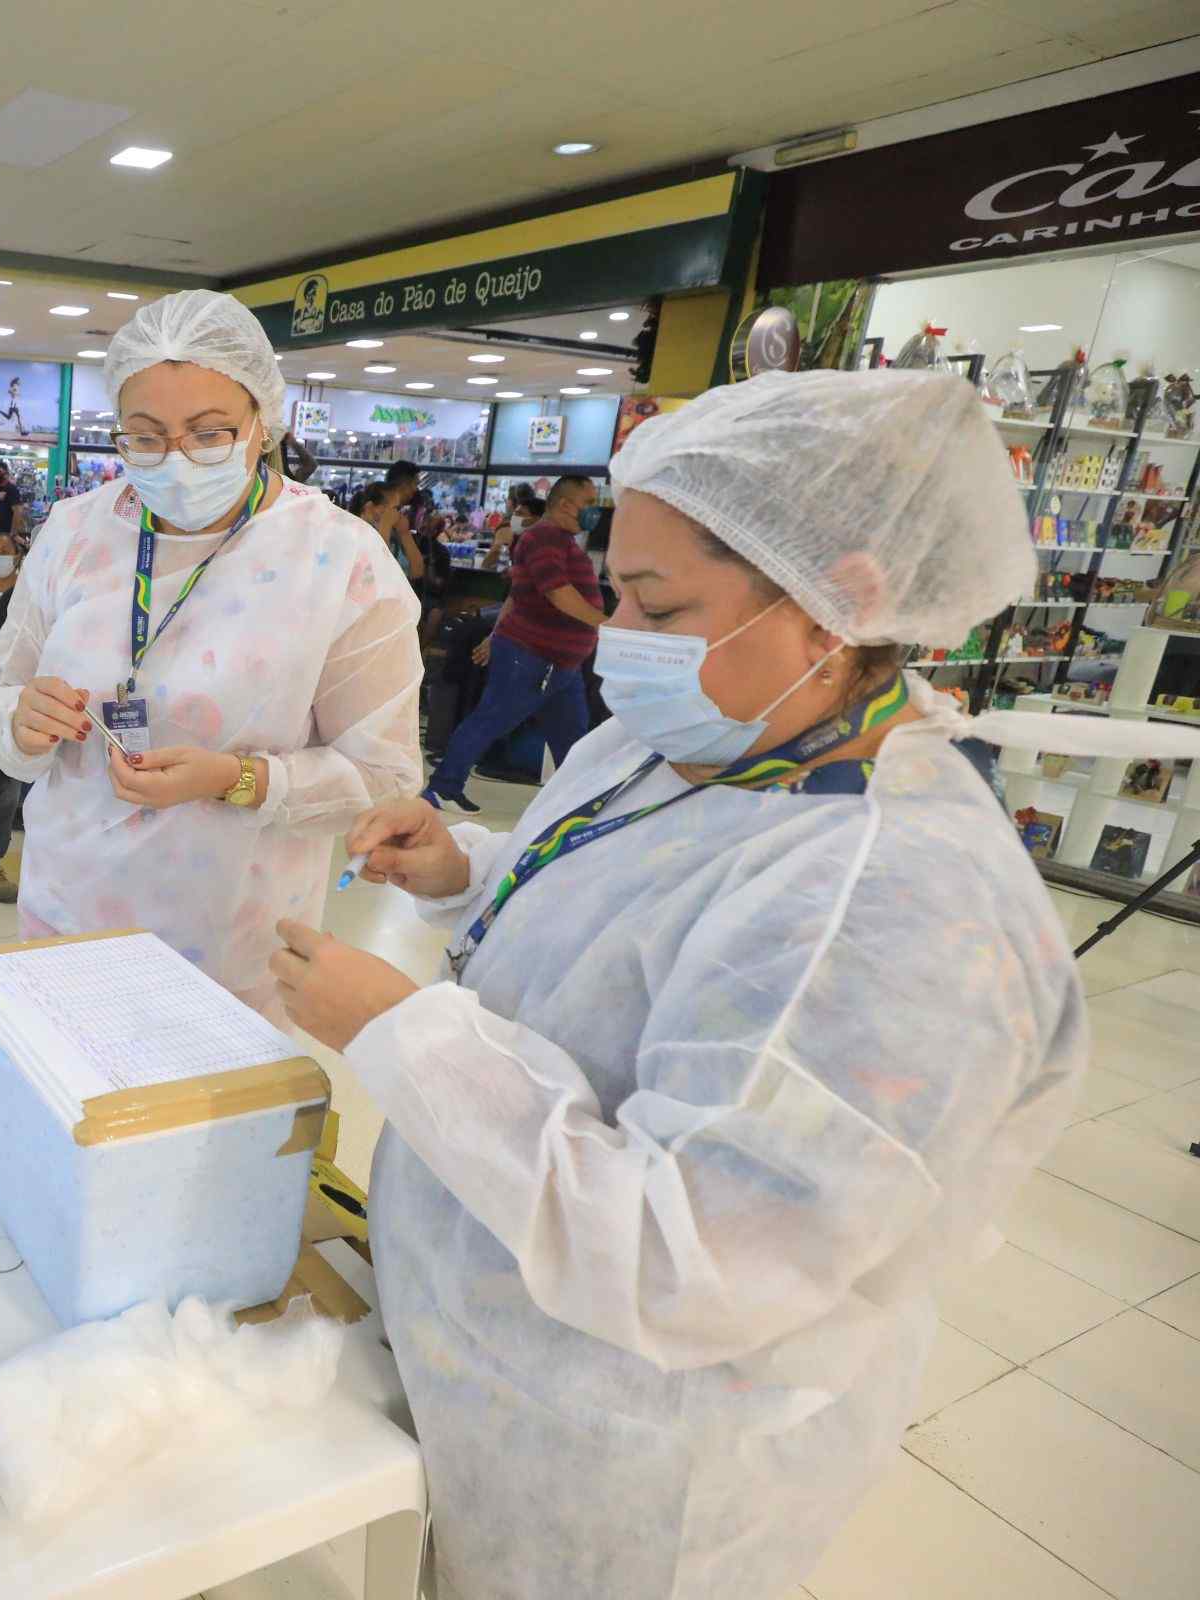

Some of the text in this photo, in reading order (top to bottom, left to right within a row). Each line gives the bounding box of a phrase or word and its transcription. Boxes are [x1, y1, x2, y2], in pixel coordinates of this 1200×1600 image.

[329, 266, 542, 324] Casa do Pão de Queijo
